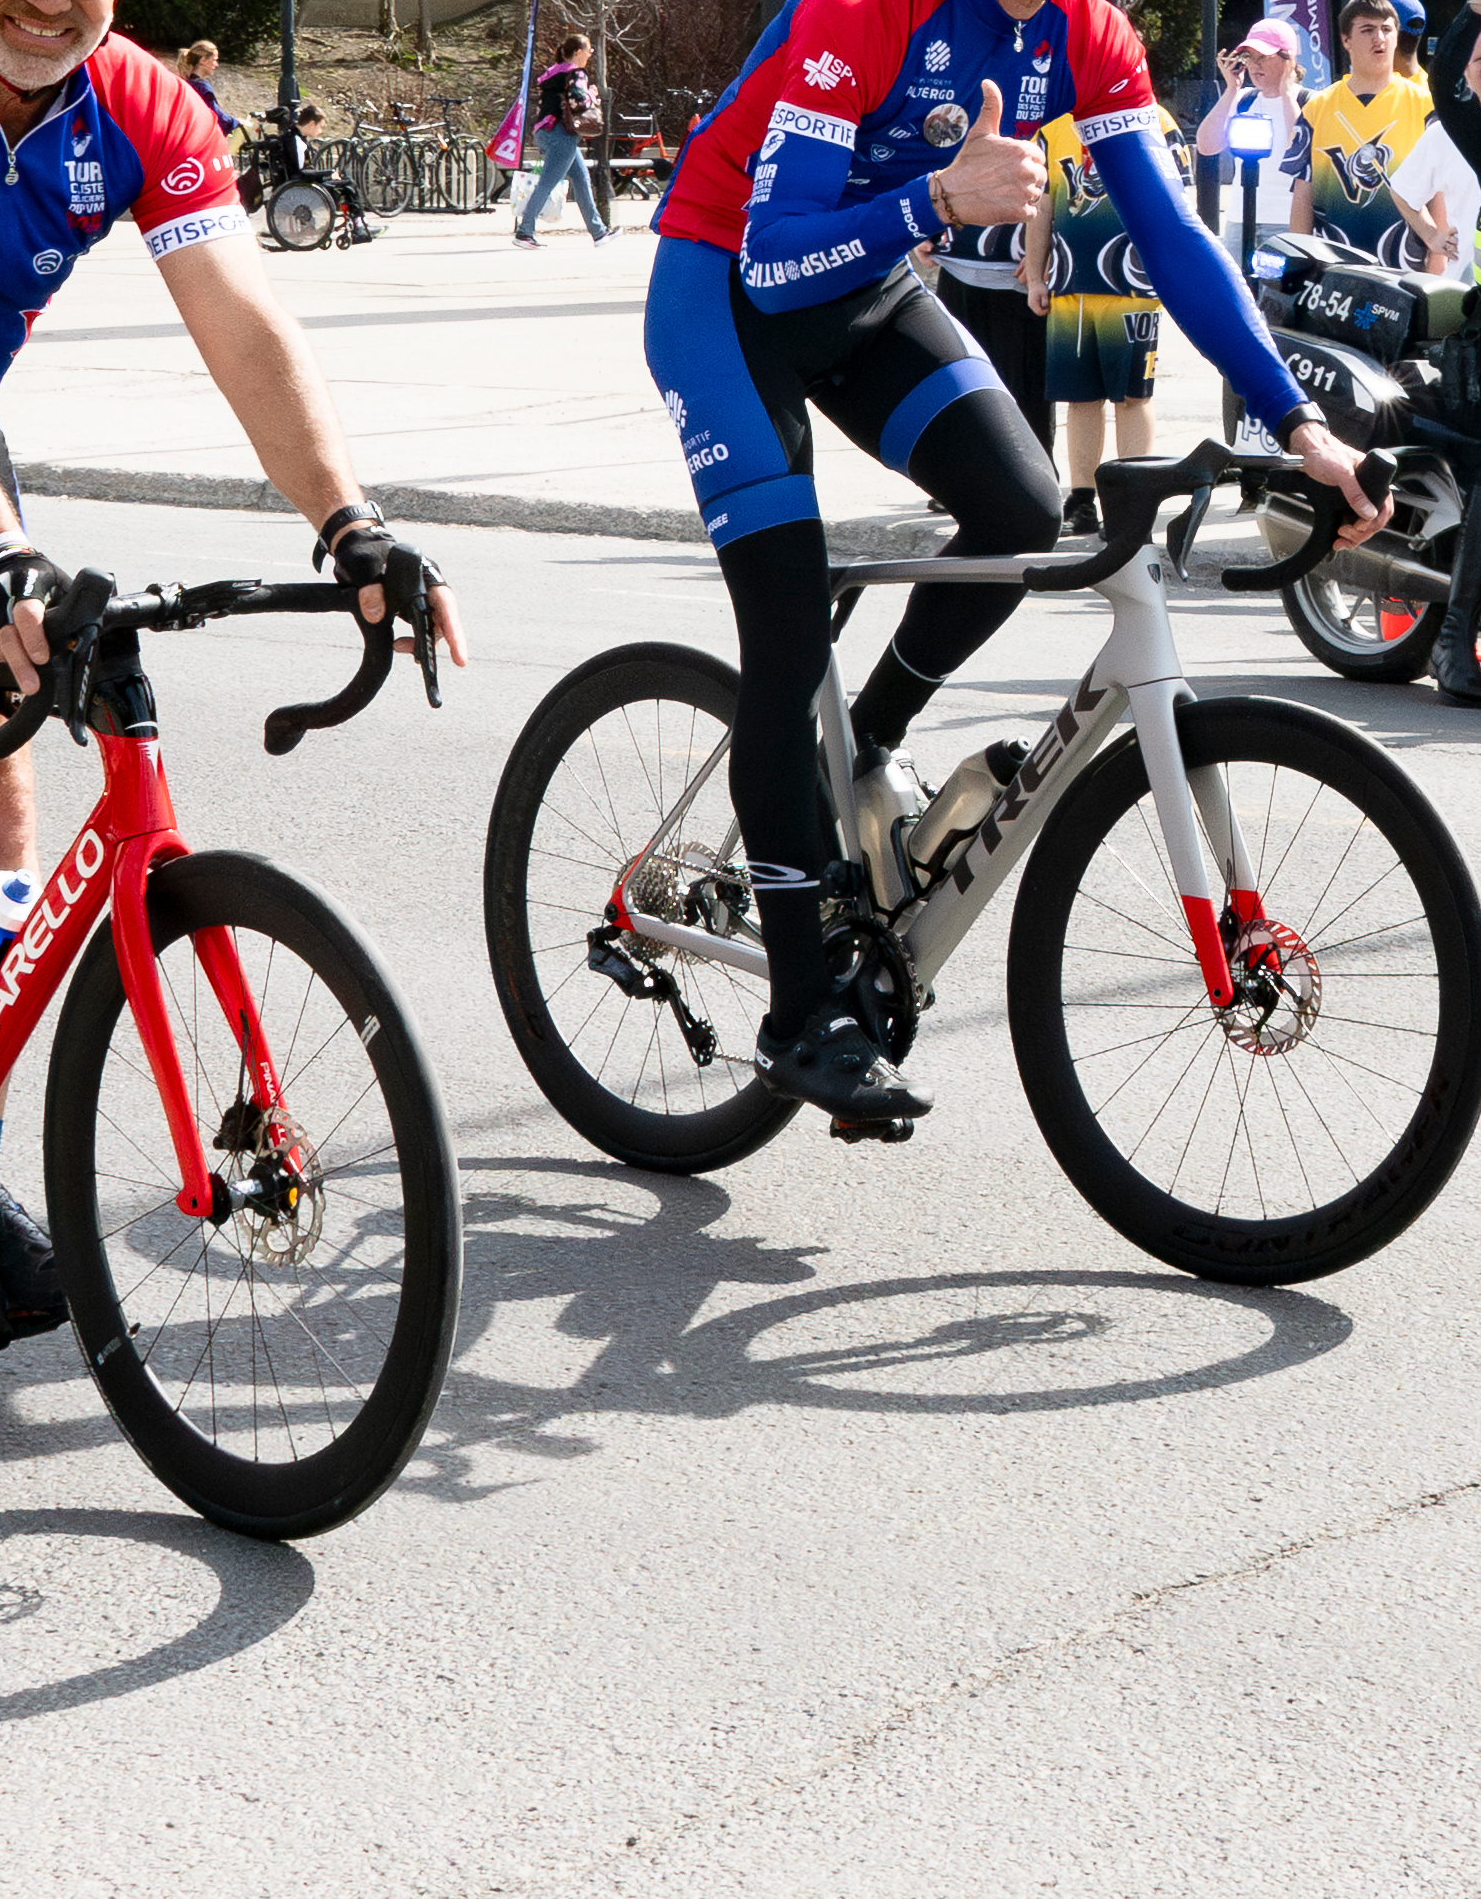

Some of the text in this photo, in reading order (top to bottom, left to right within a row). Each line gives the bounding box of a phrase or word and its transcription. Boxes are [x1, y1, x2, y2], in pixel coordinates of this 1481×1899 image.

[1297, 280, 1354, 322] 78-54
[1371, 303, 1400, 322] SPVM
[1296, 358, 1337, 392] 911
